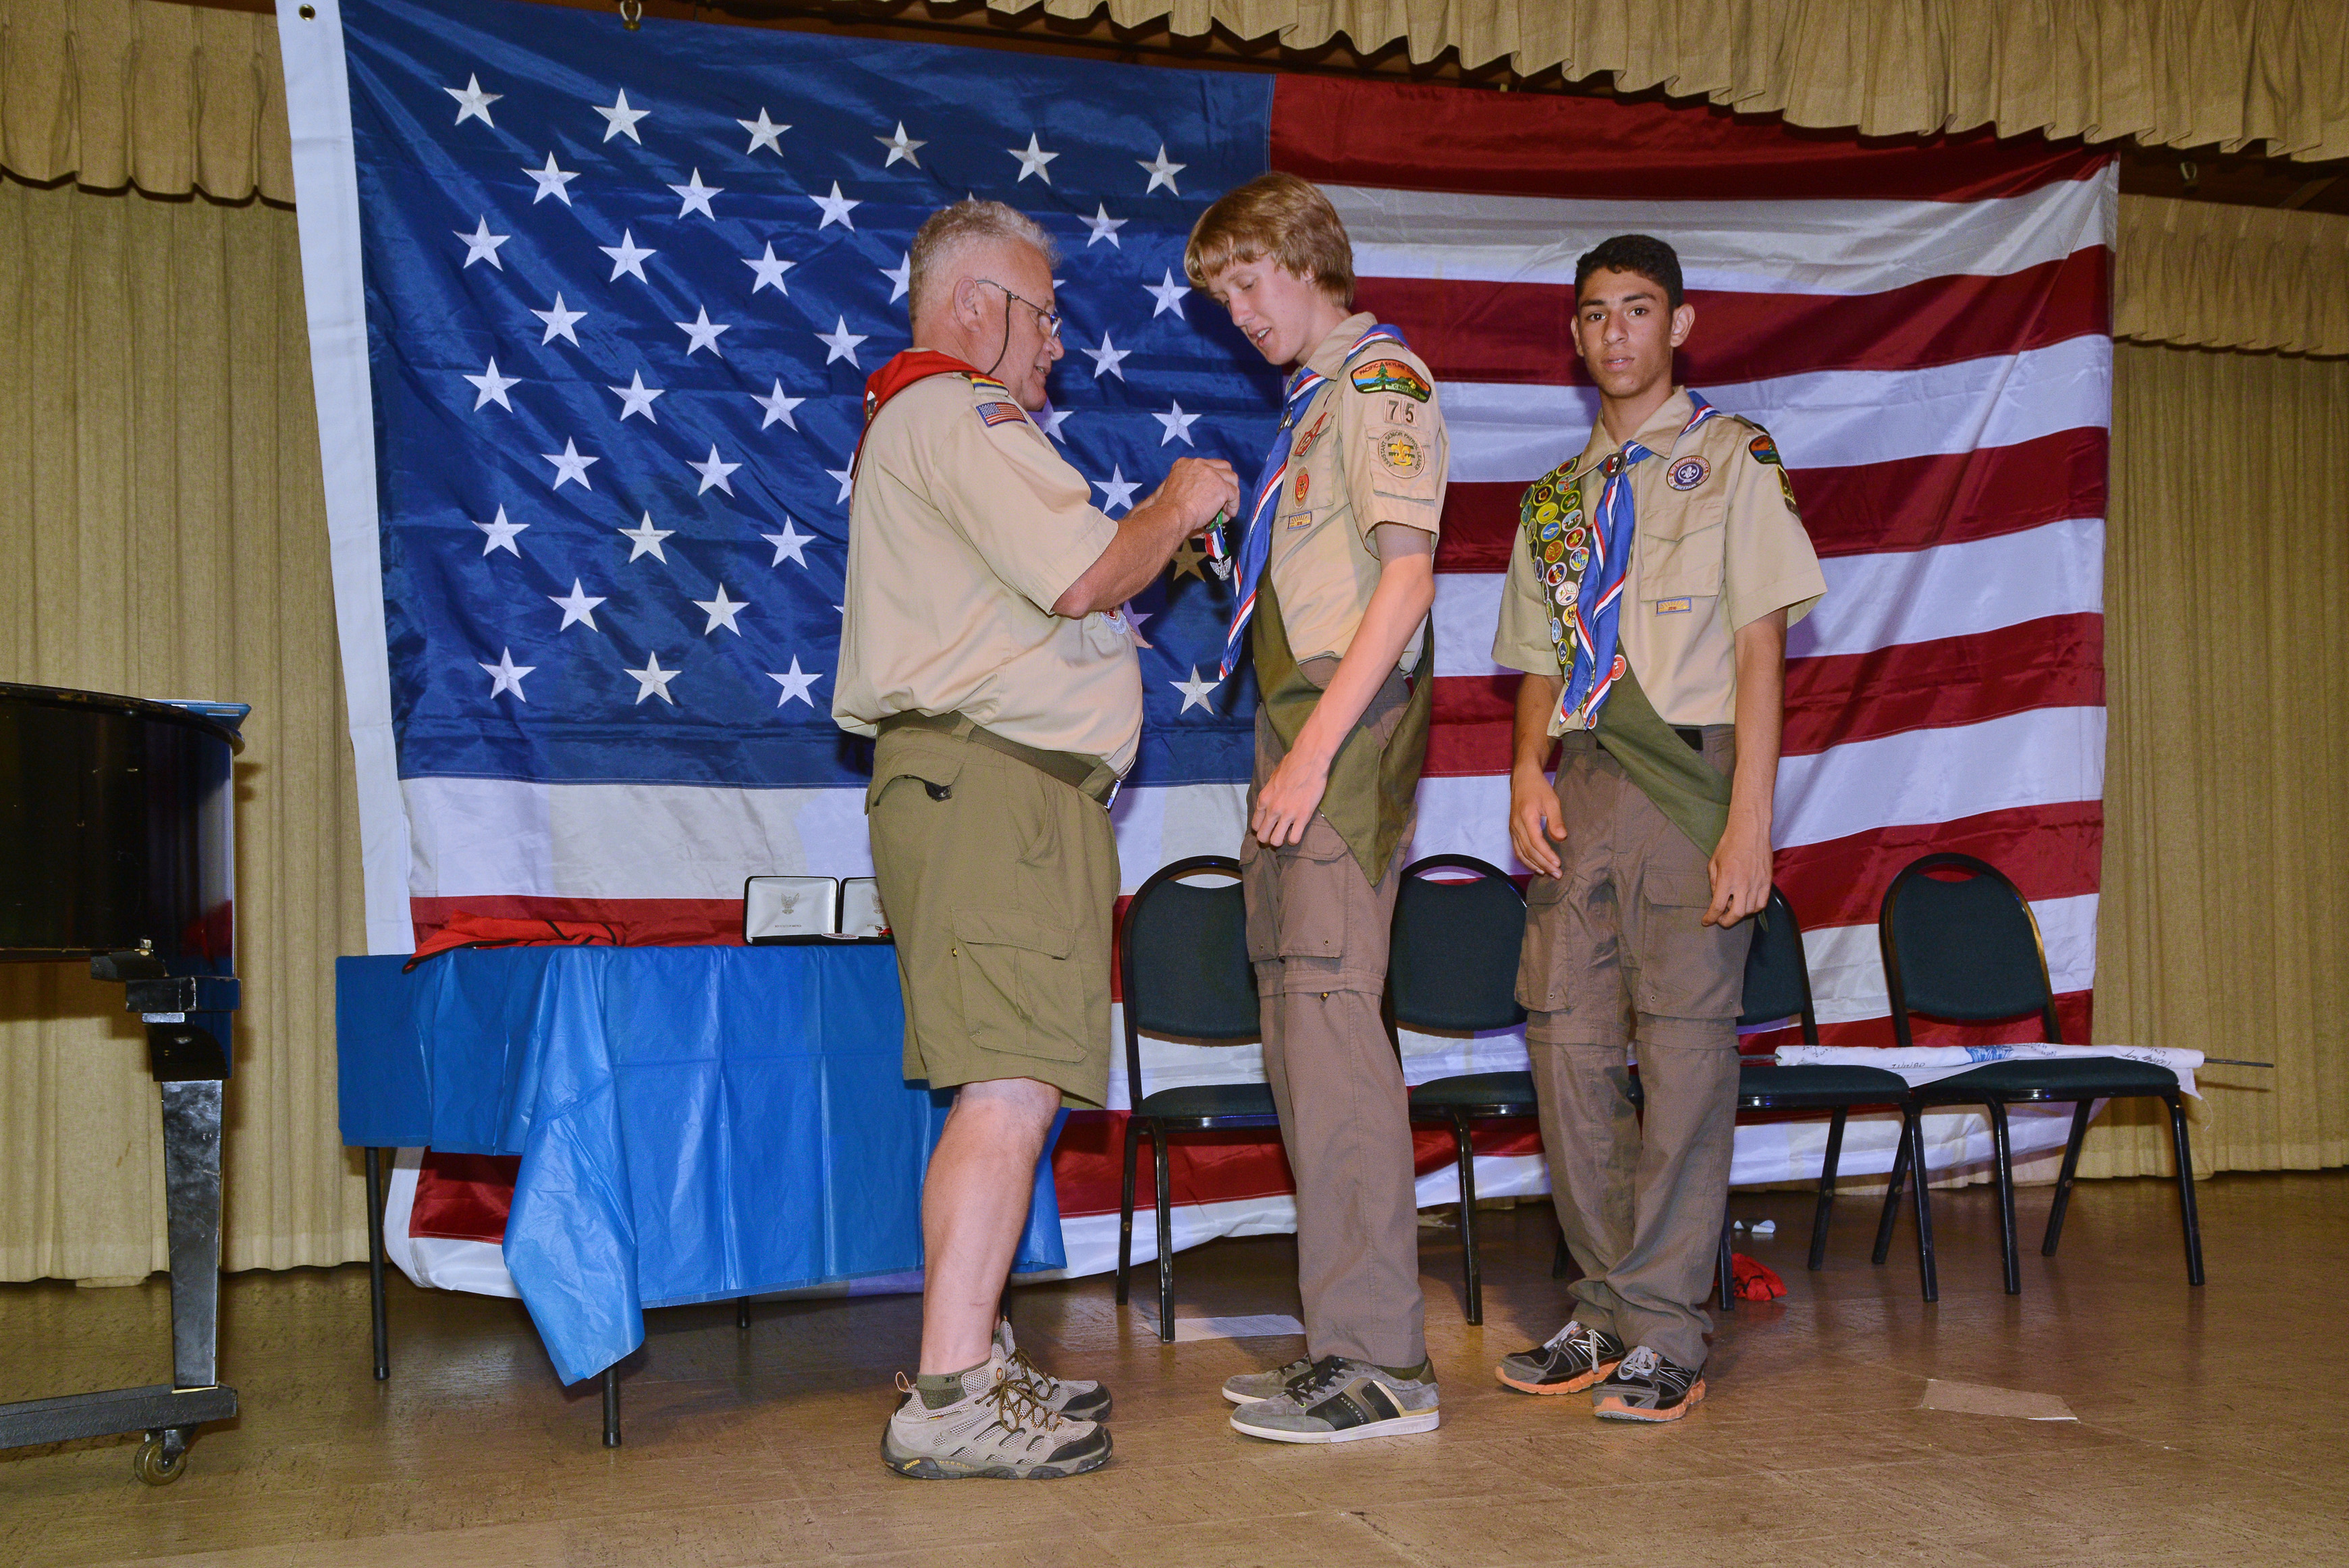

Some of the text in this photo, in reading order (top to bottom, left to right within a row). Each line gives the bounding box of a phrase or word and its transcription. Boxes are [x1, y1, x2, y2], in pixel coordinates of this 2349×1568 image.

[1359, 363, 1379, 375] PACIFIC
[1384, 361, 1405, 370] SKYLINE
[1388, 400, 1415, 423] 75
[1380, 431, 1422, 470] ASSISTANT SENIOR PATROL LEADER
[902, 1459, 921, 1470] vibram
